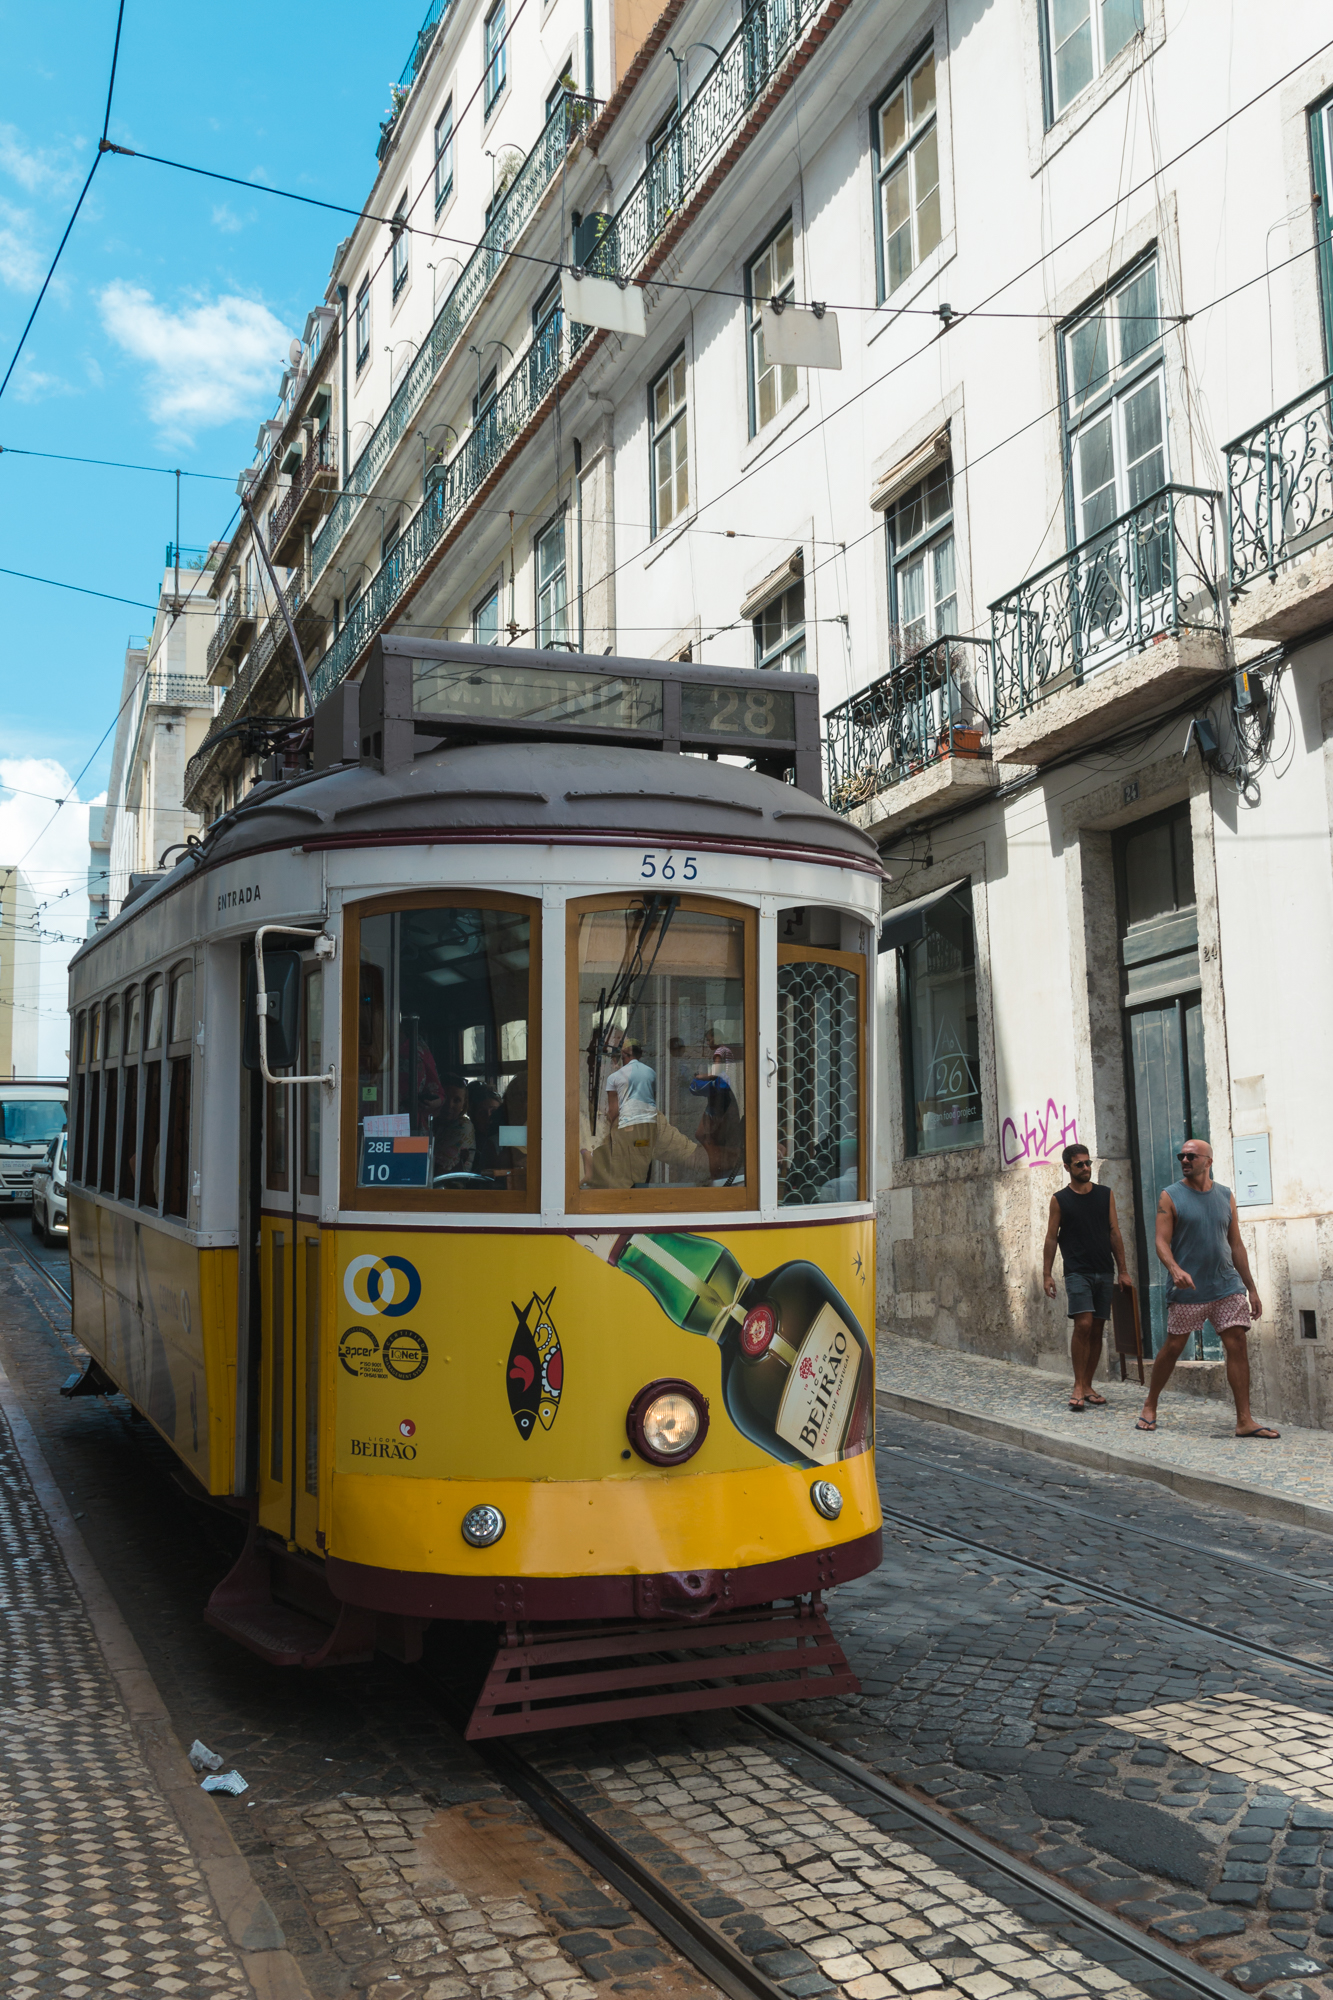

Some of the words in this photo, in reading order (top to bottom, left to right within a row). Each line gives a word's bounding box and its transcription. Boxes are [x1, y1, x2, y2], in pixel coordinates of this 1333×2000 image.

[491, 674, 639, 718] MONIZ
[709, 688, 776, 735] 28
[1125, 784, 1137, 802] 24
[641, 854, 697, 880] 565
[217, 884, 261, 911] ENTRADA
[1203, 944, 1218, 963] 24
[936, 1060, 962, 1095] 26
[943, 1110, 956, 1120] food
[957, 1106, 977, 1120] project
[368, 1142, 391, 1153] 28E
[367, 1164, 390, 1181] 10
[386, 1331, 426, 1348] CERTIFIED
[345, 1346, 372, 1358] apcer
[391, 1350, 419, 1360] IQNet
[807, 1354, 828, 1405] LICOR
[799, 1332, 847, 1451] BEIRÃO
[823, 1412, 834, 1437] LICOR
[831, 1400, 838, 1411] DE
[836, 1354, 850, 1396] PORTUGAL
[351, 1439, 417, 1460] BEIRÃO
